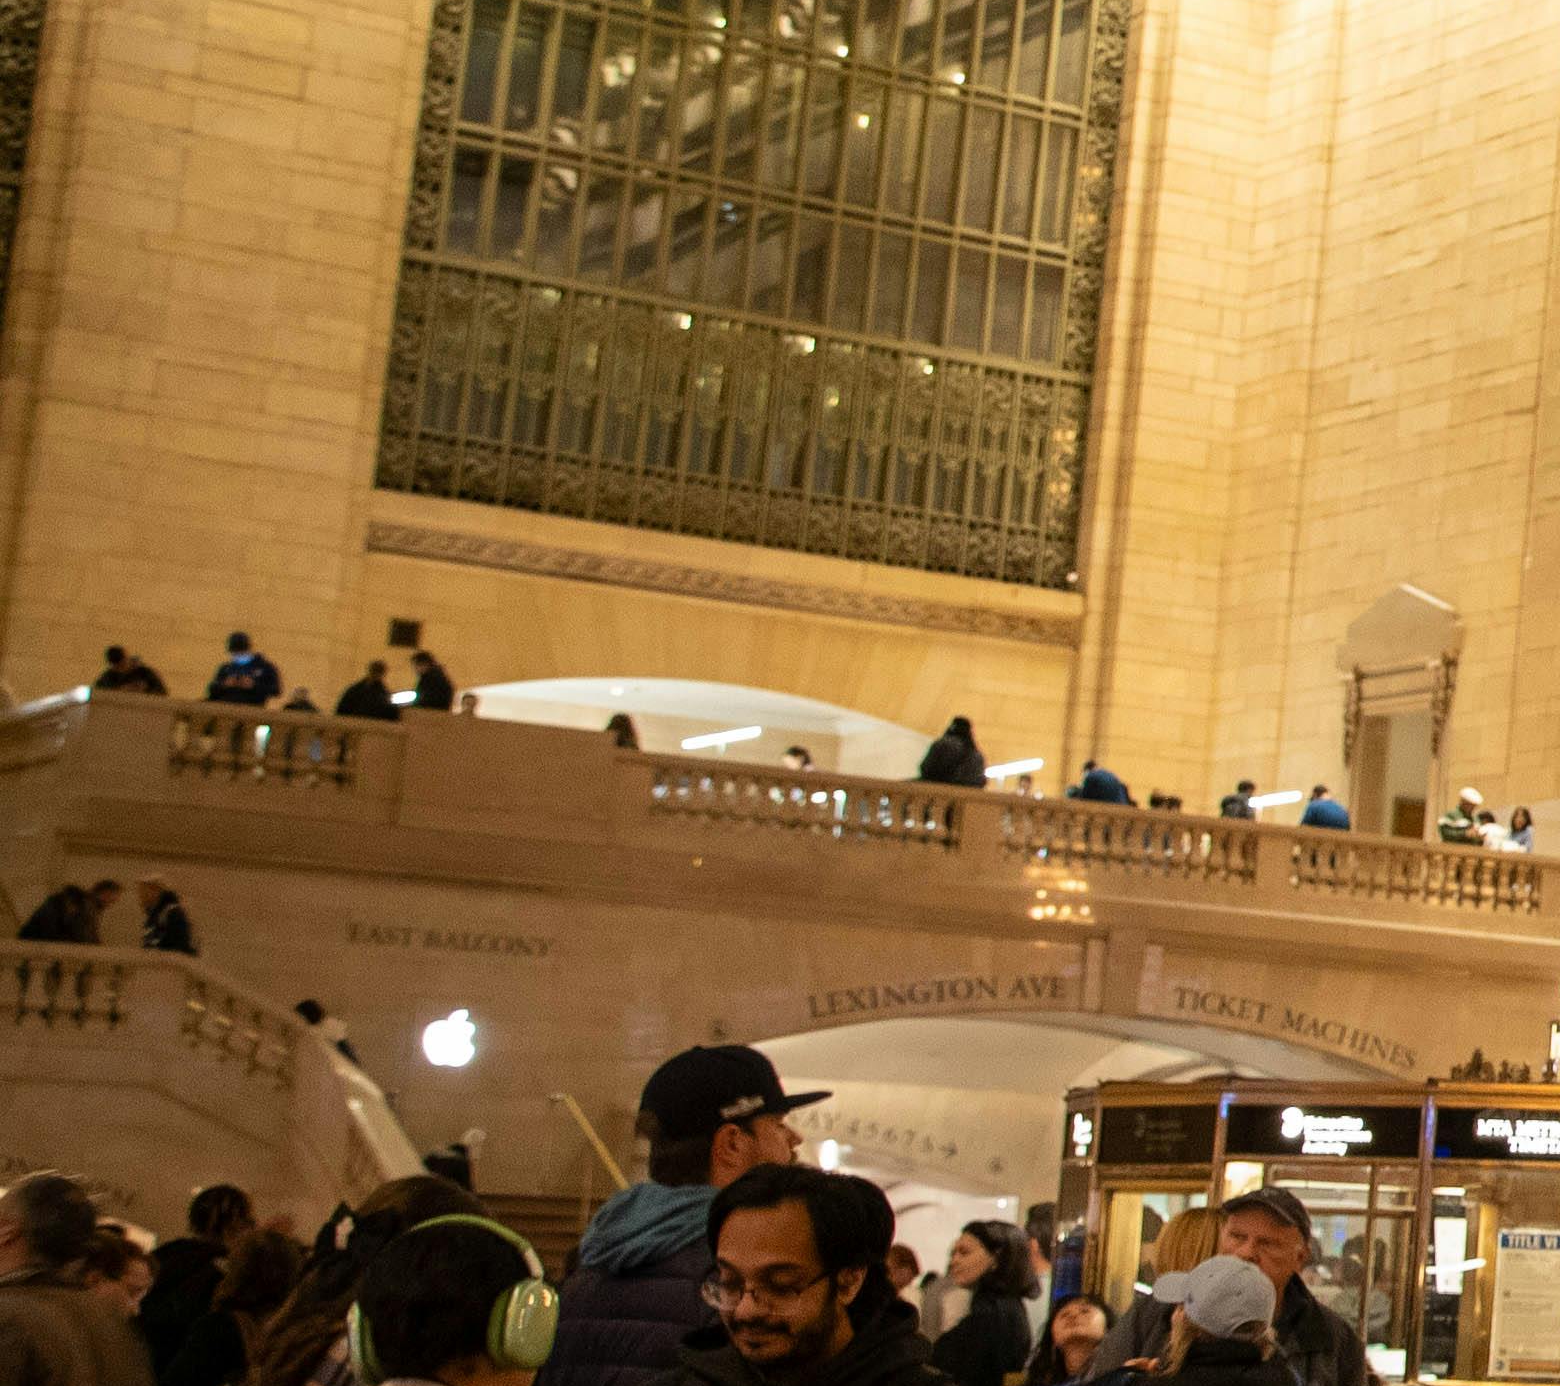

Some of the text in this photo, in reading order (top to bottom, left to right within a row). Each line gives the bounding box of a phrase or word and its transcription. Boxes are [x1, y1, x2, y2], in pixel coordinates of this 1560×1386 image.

[807, 974, 1067, 1018] LEXINGTON AVE
[1174, 986, 1418, 1067] TICKET MACHINES
[1477, 1120, 1513, 1137] MTA
